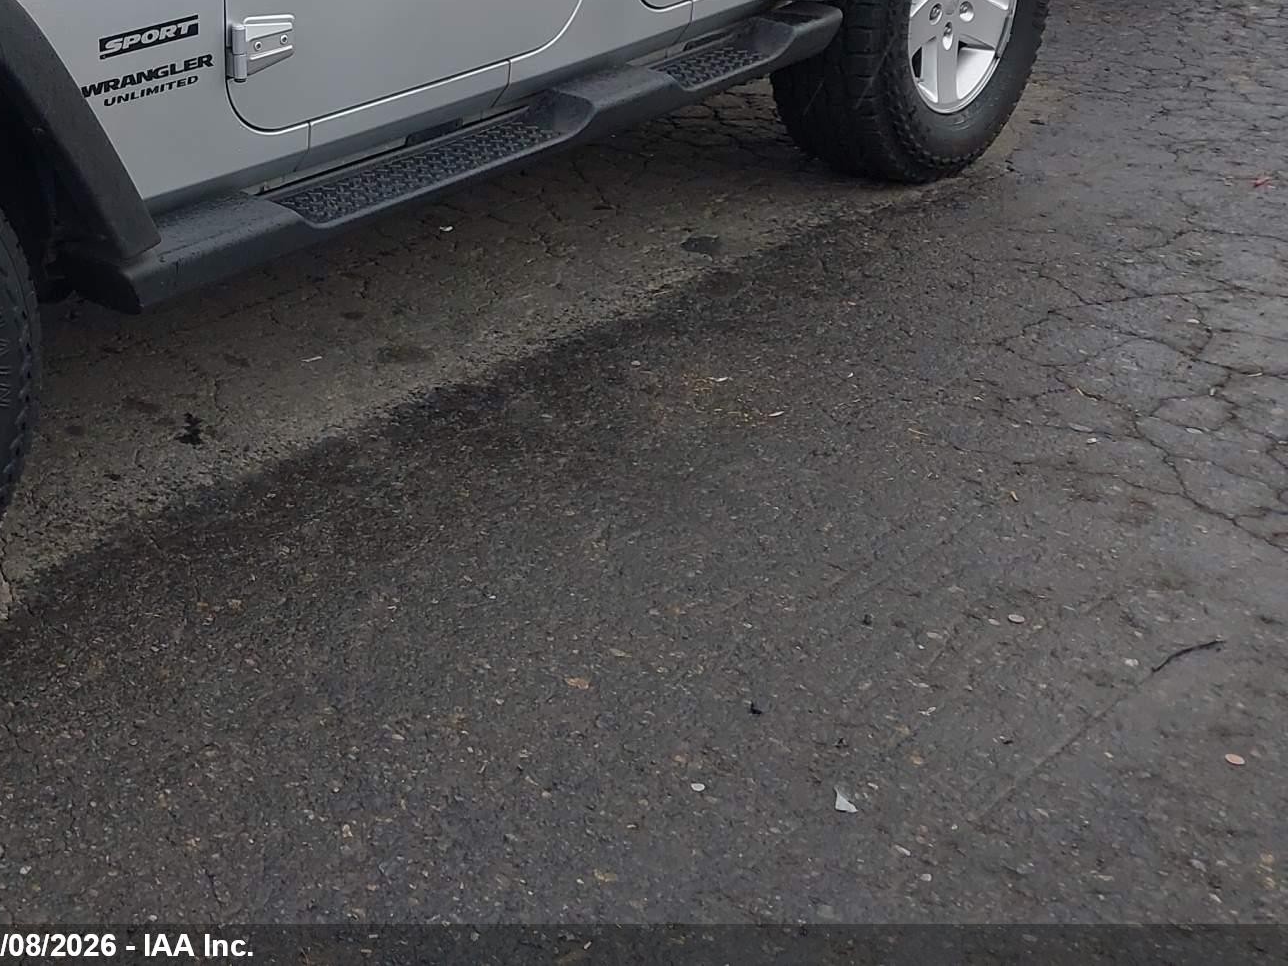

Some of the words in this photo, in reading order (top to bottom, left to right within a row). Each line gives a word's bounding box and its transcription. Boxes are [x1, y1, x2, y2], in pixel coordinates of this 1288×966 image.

[100, 18, 200, 54] SPORT
[81, 54, 214, 98] WRANGLER
[103, 75, 199, 107] UNLIMITED
